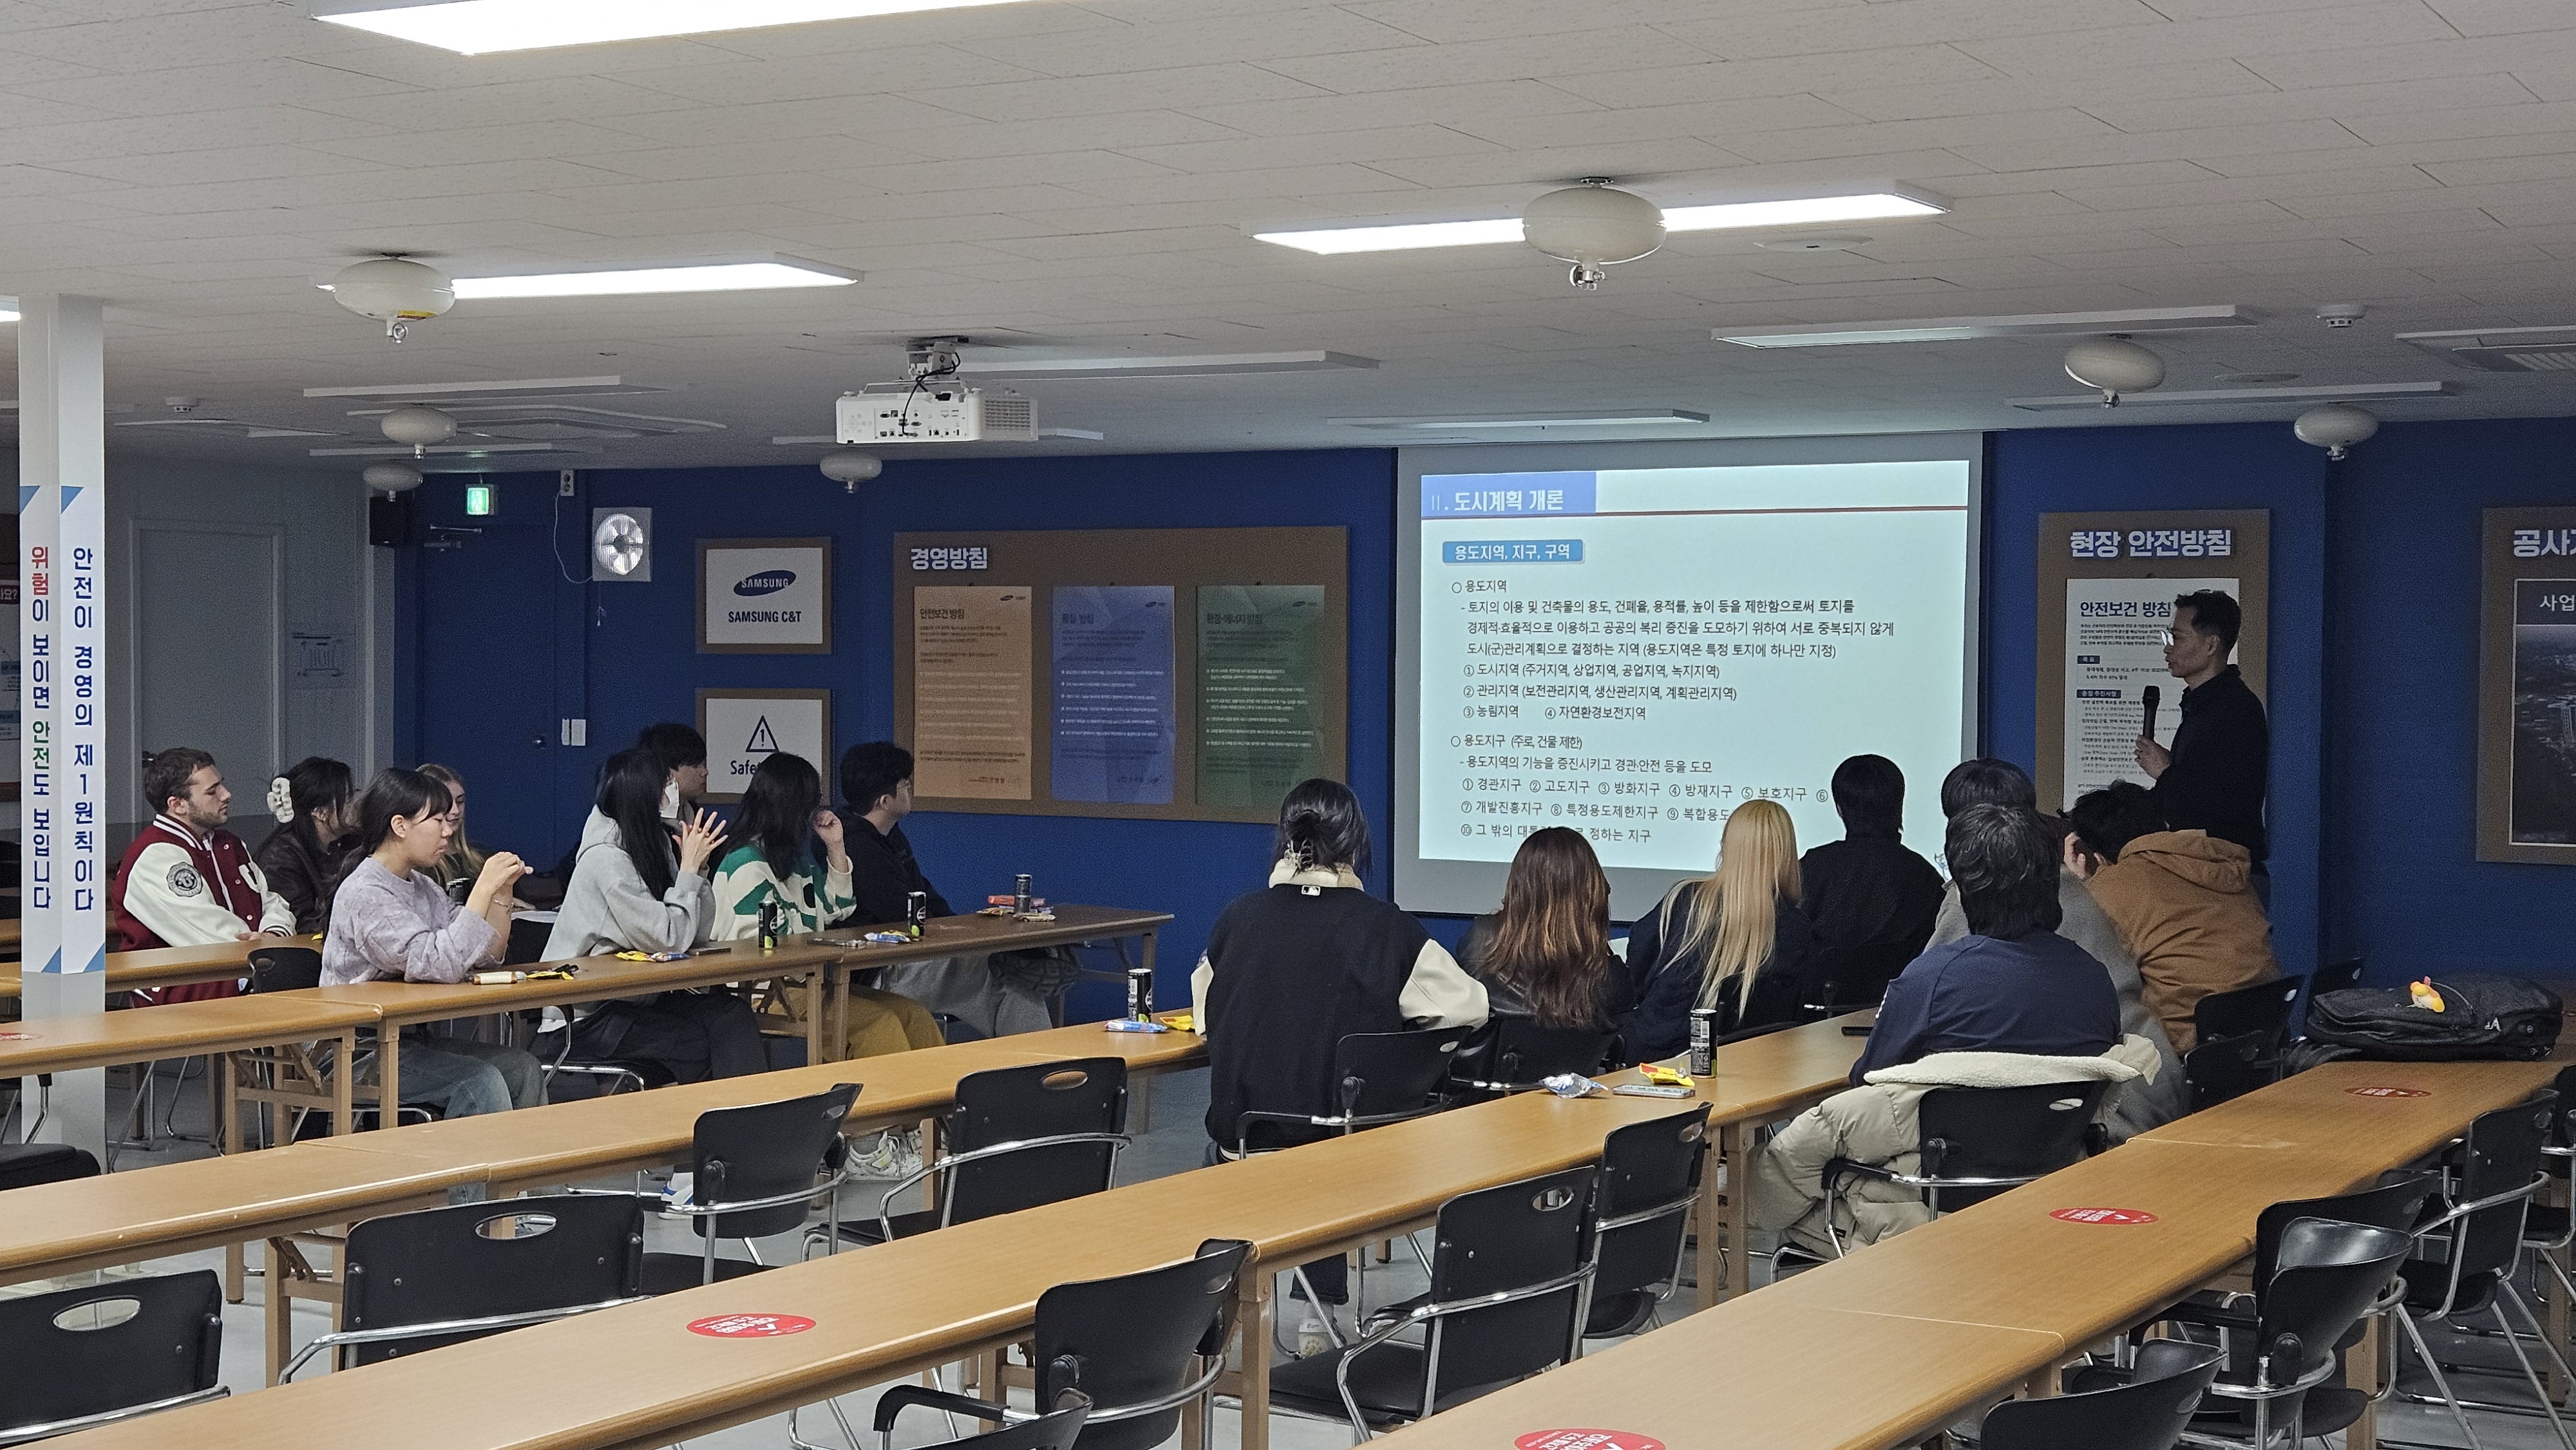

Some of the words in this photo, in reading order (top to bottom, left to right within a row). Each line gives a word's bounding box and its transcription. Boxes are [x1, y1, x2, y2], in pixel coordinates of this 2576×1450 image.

[1455, 491, 1522, 512] 도시계획
[1530, 490, 1563, 511] 개론
[2070, 531, 2121, 558] 현장
[2128, 530, 2231, 556] 안전방침
[2514, 529, 2576, 557] 공사
[911, 547, 988, 570] 경영방침
[1455, 545, 1508, 560] 용도지역,
[1512, 545, 1540, 560] 지구,
[1545, 544, 1569, 559] 구역
[32, 547, 49, 621] 위험이
[73, 547, 93, 628] 안전이
[741, 579, 789, 588] SAMSUNG
[1466, 580, 1506, 592] 용도지역
[920, 608, 948, 619] 안전보건
[949, 609, 964, 619] 방침
[1468, 601, 1499, 614] 토지의
[1503, 601, 1524, 614] 이용
[1528, 601, 1537, 614] 및
[1542, 600, 1584, 614] 건축물의
[1588, 601, 1611, 614] 용도,
[1615, 600, 1649, 614] 건폐율,
[1653, 600, 1688, 614] 용적률,
[1692, 600, 1714, 614] 높이
[1718, 600, 1741, 612] 등을
[1745, 600, 1814, 614] 제한함으로써
[1819, 599, 1854, 614] 토지를
[2080, 602, 2137, 617] 안전보건
[2143, 602, 2170, 617] 방침
[728, 612, 778, 623] SAMSUNG
[782, 611, 801, 622] C&T
[1557, 621, 1600, 634] 이용하고
[1604, 621, 1635, 634] 공공의
[1640, 621, 1661, 635] 복리
[1665, 621, 1699, 634] 증진을
[1703, 621, 1747, 636] 도모하기
[1752, 621, 1786, 636] 위하여
[1791, 622, 1814, 636] 서로
[1818, 622, 1865, 636] 중복되지
[1870, 622, 1893, 636] 않게
[1467, 643, 1567, 656] 도시(군)관리계획으로
[1572, 643, 1615, 656] 결정하는
[1618, 643, 1638, 656] 지역
[1643, 643, 1702, 657] (용도지역은
[1706, 644, 1727, 657] 특정
[1732, 644, 1766, 657] 토지에
[1771, 644, 1805, 657] 하나만
[1810, 645, 1835, 659] 지정)
[33, 634, 50, 709] 보이면
[1477, 663, 1519, 676] 도시지역
[1522, 664, 1569, 677] (주거지역,
[1573, 664, 1618, 677] 상업지역,
[1622, 664, 1667, 678] 공업지역,
[1672, 664, 1719, 679] 녹지지역)
[74, 646, 93, 726] 경영의
[1477, 684, 1518, 697] 관리지역
[1522, 685, 1591, 699] (보전관리지역,
[1595, 686, 1662, 699] 생산관리지역,
[1666, 686, 1736, 701] 계획관리지역)
[1477, 705, 1518, 718] 농림지역
[1559, 706, 1645, 720] 자연환경보전지역
[1464, 735, 1505, 748] 용도지구
[1537, 736, 1557, 748] 건물
[1560, 737, 1582, 750] 제한)
[33, 721, 50, 795] 안전도
[1467, 756, 1519, 769] 용도지역의
[1523, 757, 1554, 769] 기능을
[1558, 758, 1611, 771] 증진시키고
[1664, 760, 1686, 773] 등을
[1690, 762, 1712, 773] 도모
[1478, 778, 1521, 792] 경관지구
[1545, 780, 1589, 794] 고도지구
[1615, 782, 1660, 796] 방화지구
[1686, 784, 1732, 798] 방재지구
[1758, 787, 1807, 802] 보호지구
[1476, 801, 1542, 815] 개발진흥지구
[1567, 804, 1658, 820] 특정용도제한지구
[1683, 807, 1734, 821] 복합용도
[1476, 825, 1486, 834] 그
[1492, 824, 1511, 837] 밖의
[1590, 828, 1623, 841] 정하는
[1629, 830, 1651, 843] 지구
[33, 808, 51, 909] 보입니다
